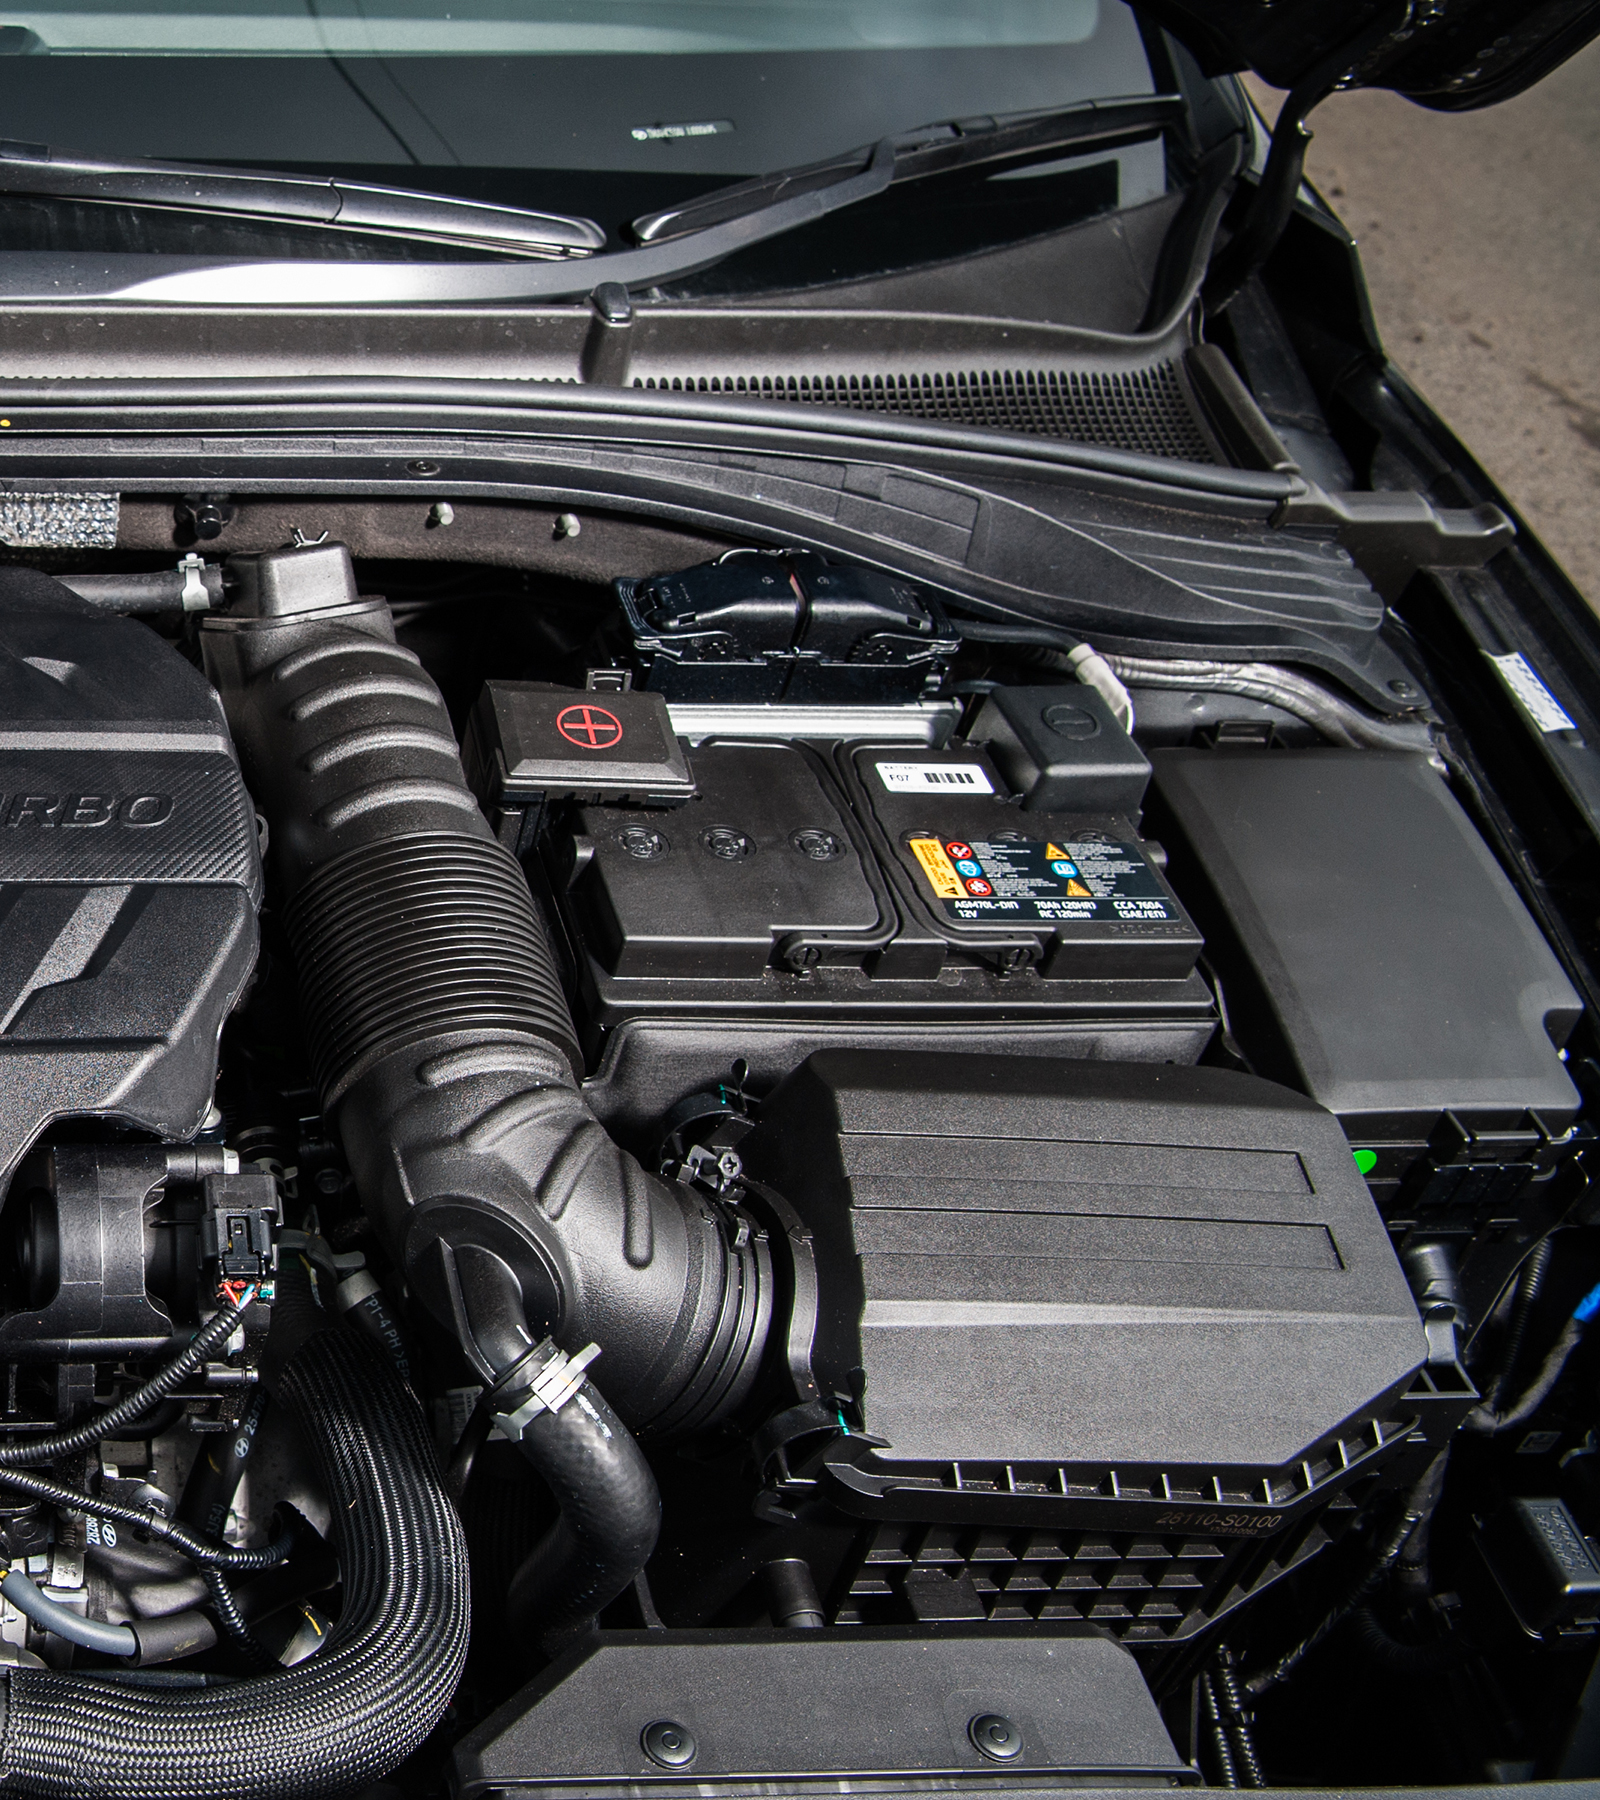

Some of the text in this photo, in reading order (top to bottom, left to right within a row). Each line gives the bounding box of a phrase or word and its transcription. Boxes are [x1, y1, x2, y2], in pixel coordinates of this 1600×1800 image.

[888, 774, 909, 782] F07
[1033, 901, 1061, 910] 70Ah
[1062, 901, 1098, 910] (20HR)
[1112, 901, 1137, 910] CCA
[957, 909, 978, 918] 12V
[1038, 910, 1055, 919] RC
[1056, 910, 1092, 919] 120min
[364, 1294, 392, 1329] P1-4
[384, 1328, 402, 1349] PH
[1155, 1510, 1283, 1528] 28110-S0100
